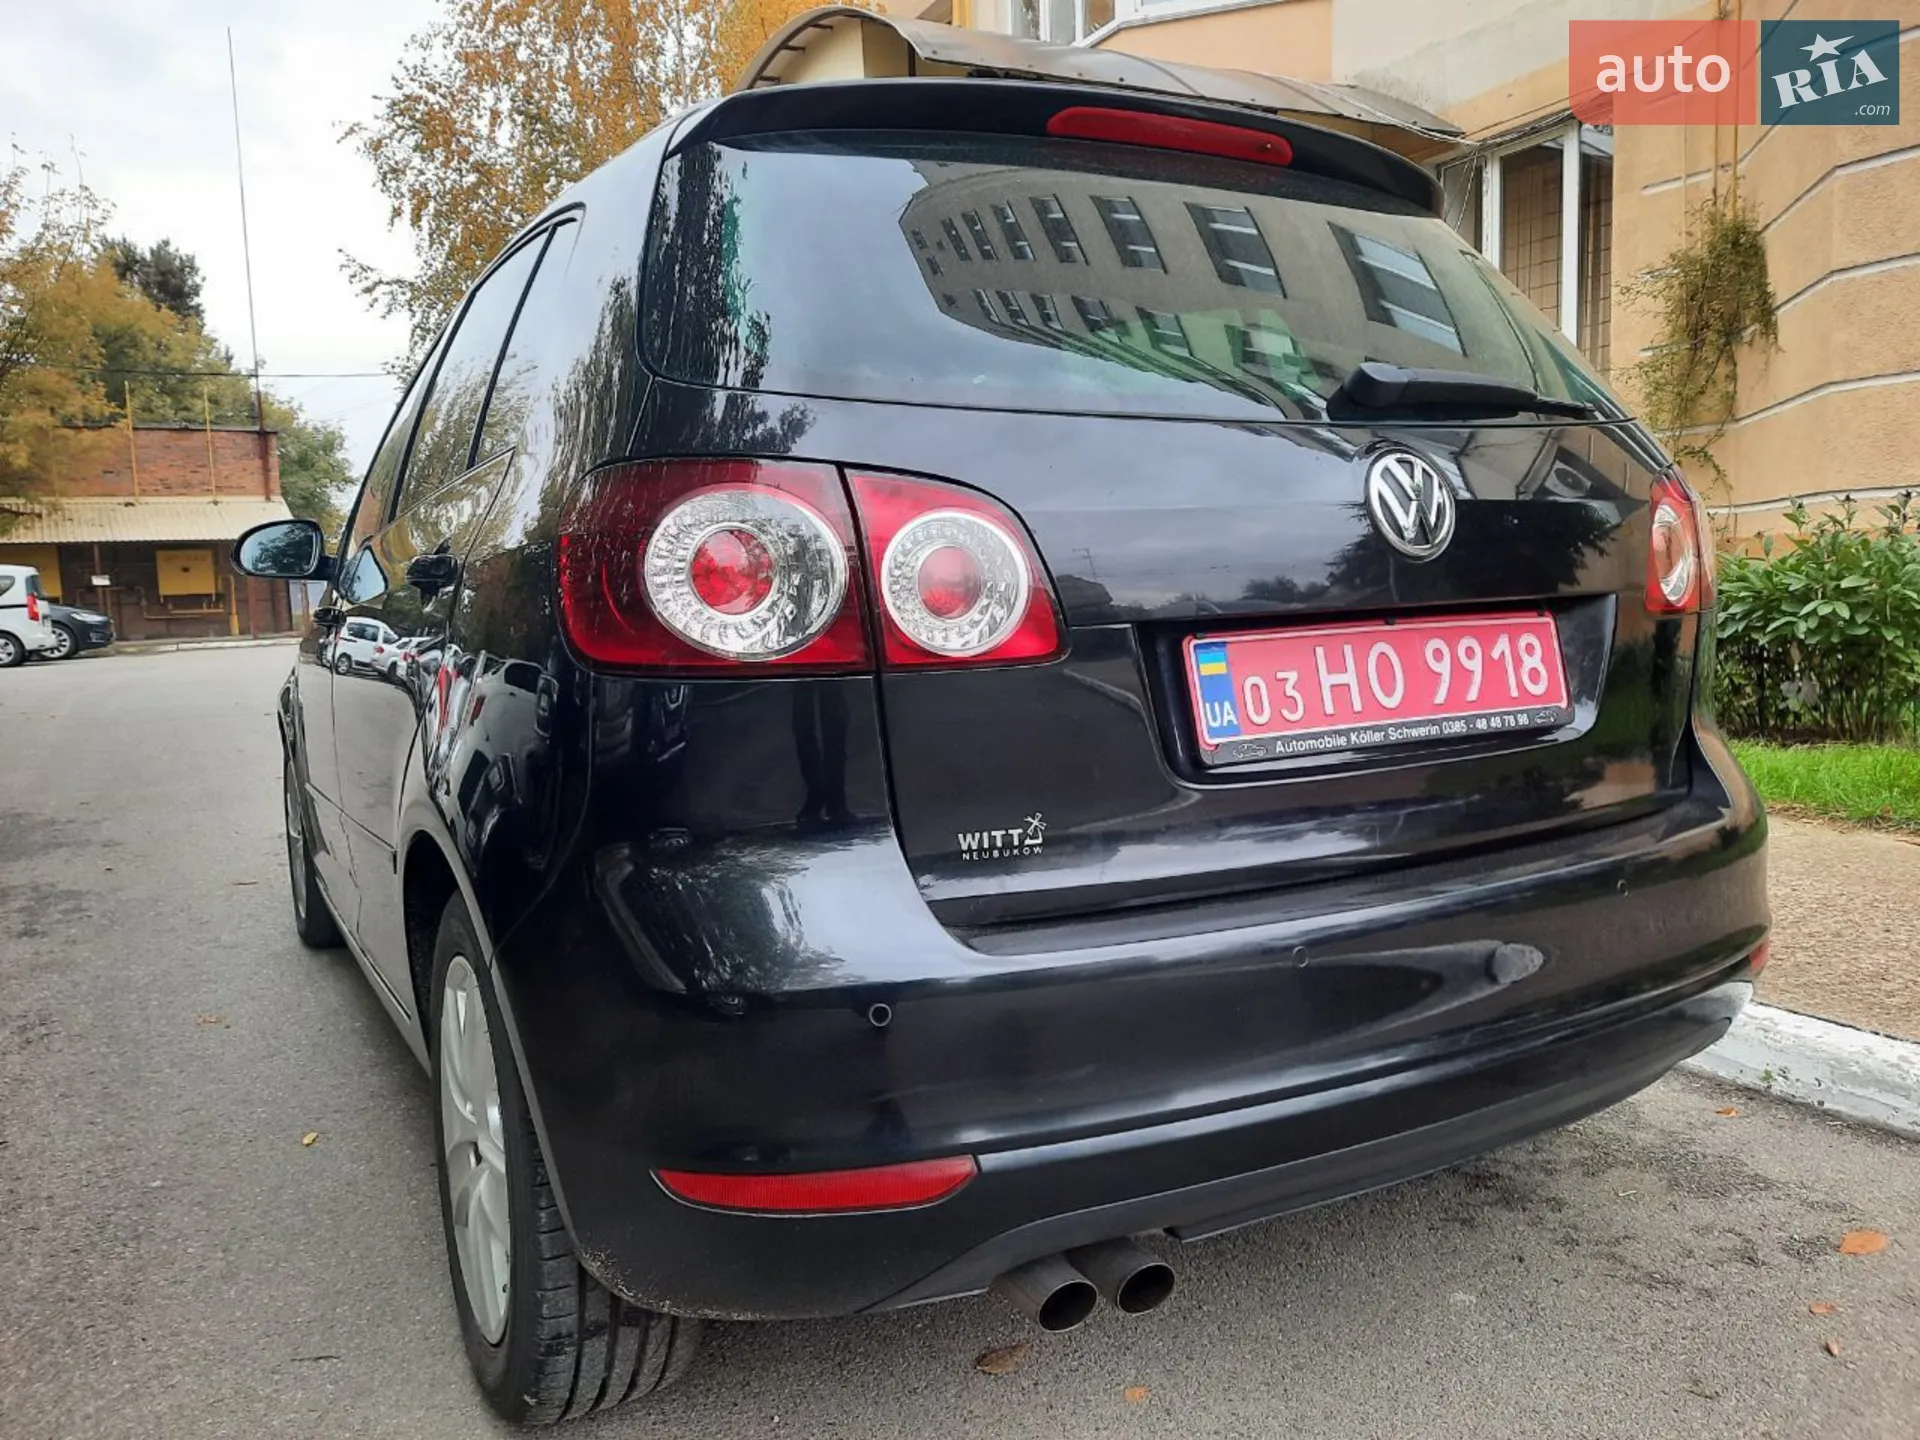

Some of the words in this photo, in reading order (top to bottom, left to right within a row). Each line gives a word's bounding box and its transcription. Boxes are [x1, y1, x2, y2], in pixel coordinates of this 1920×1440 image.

[1243, 670, 1305, 726] 03
[1313, 643, 1404, 715] HO
[1424, 633, 1549, 705] 9918
[1204, 700, 1238, 727] UA
[1275, 733, 1348, 753] Automobile
[1350, 728, 1385, 745] Köller
[1388, 721, 1440, 741] Schwerin
[1442, 719, 1467, 735] 0385
[958, 828, 1023, 851] WITT
[962, 846, 1043, 861] NEUBUKOW
